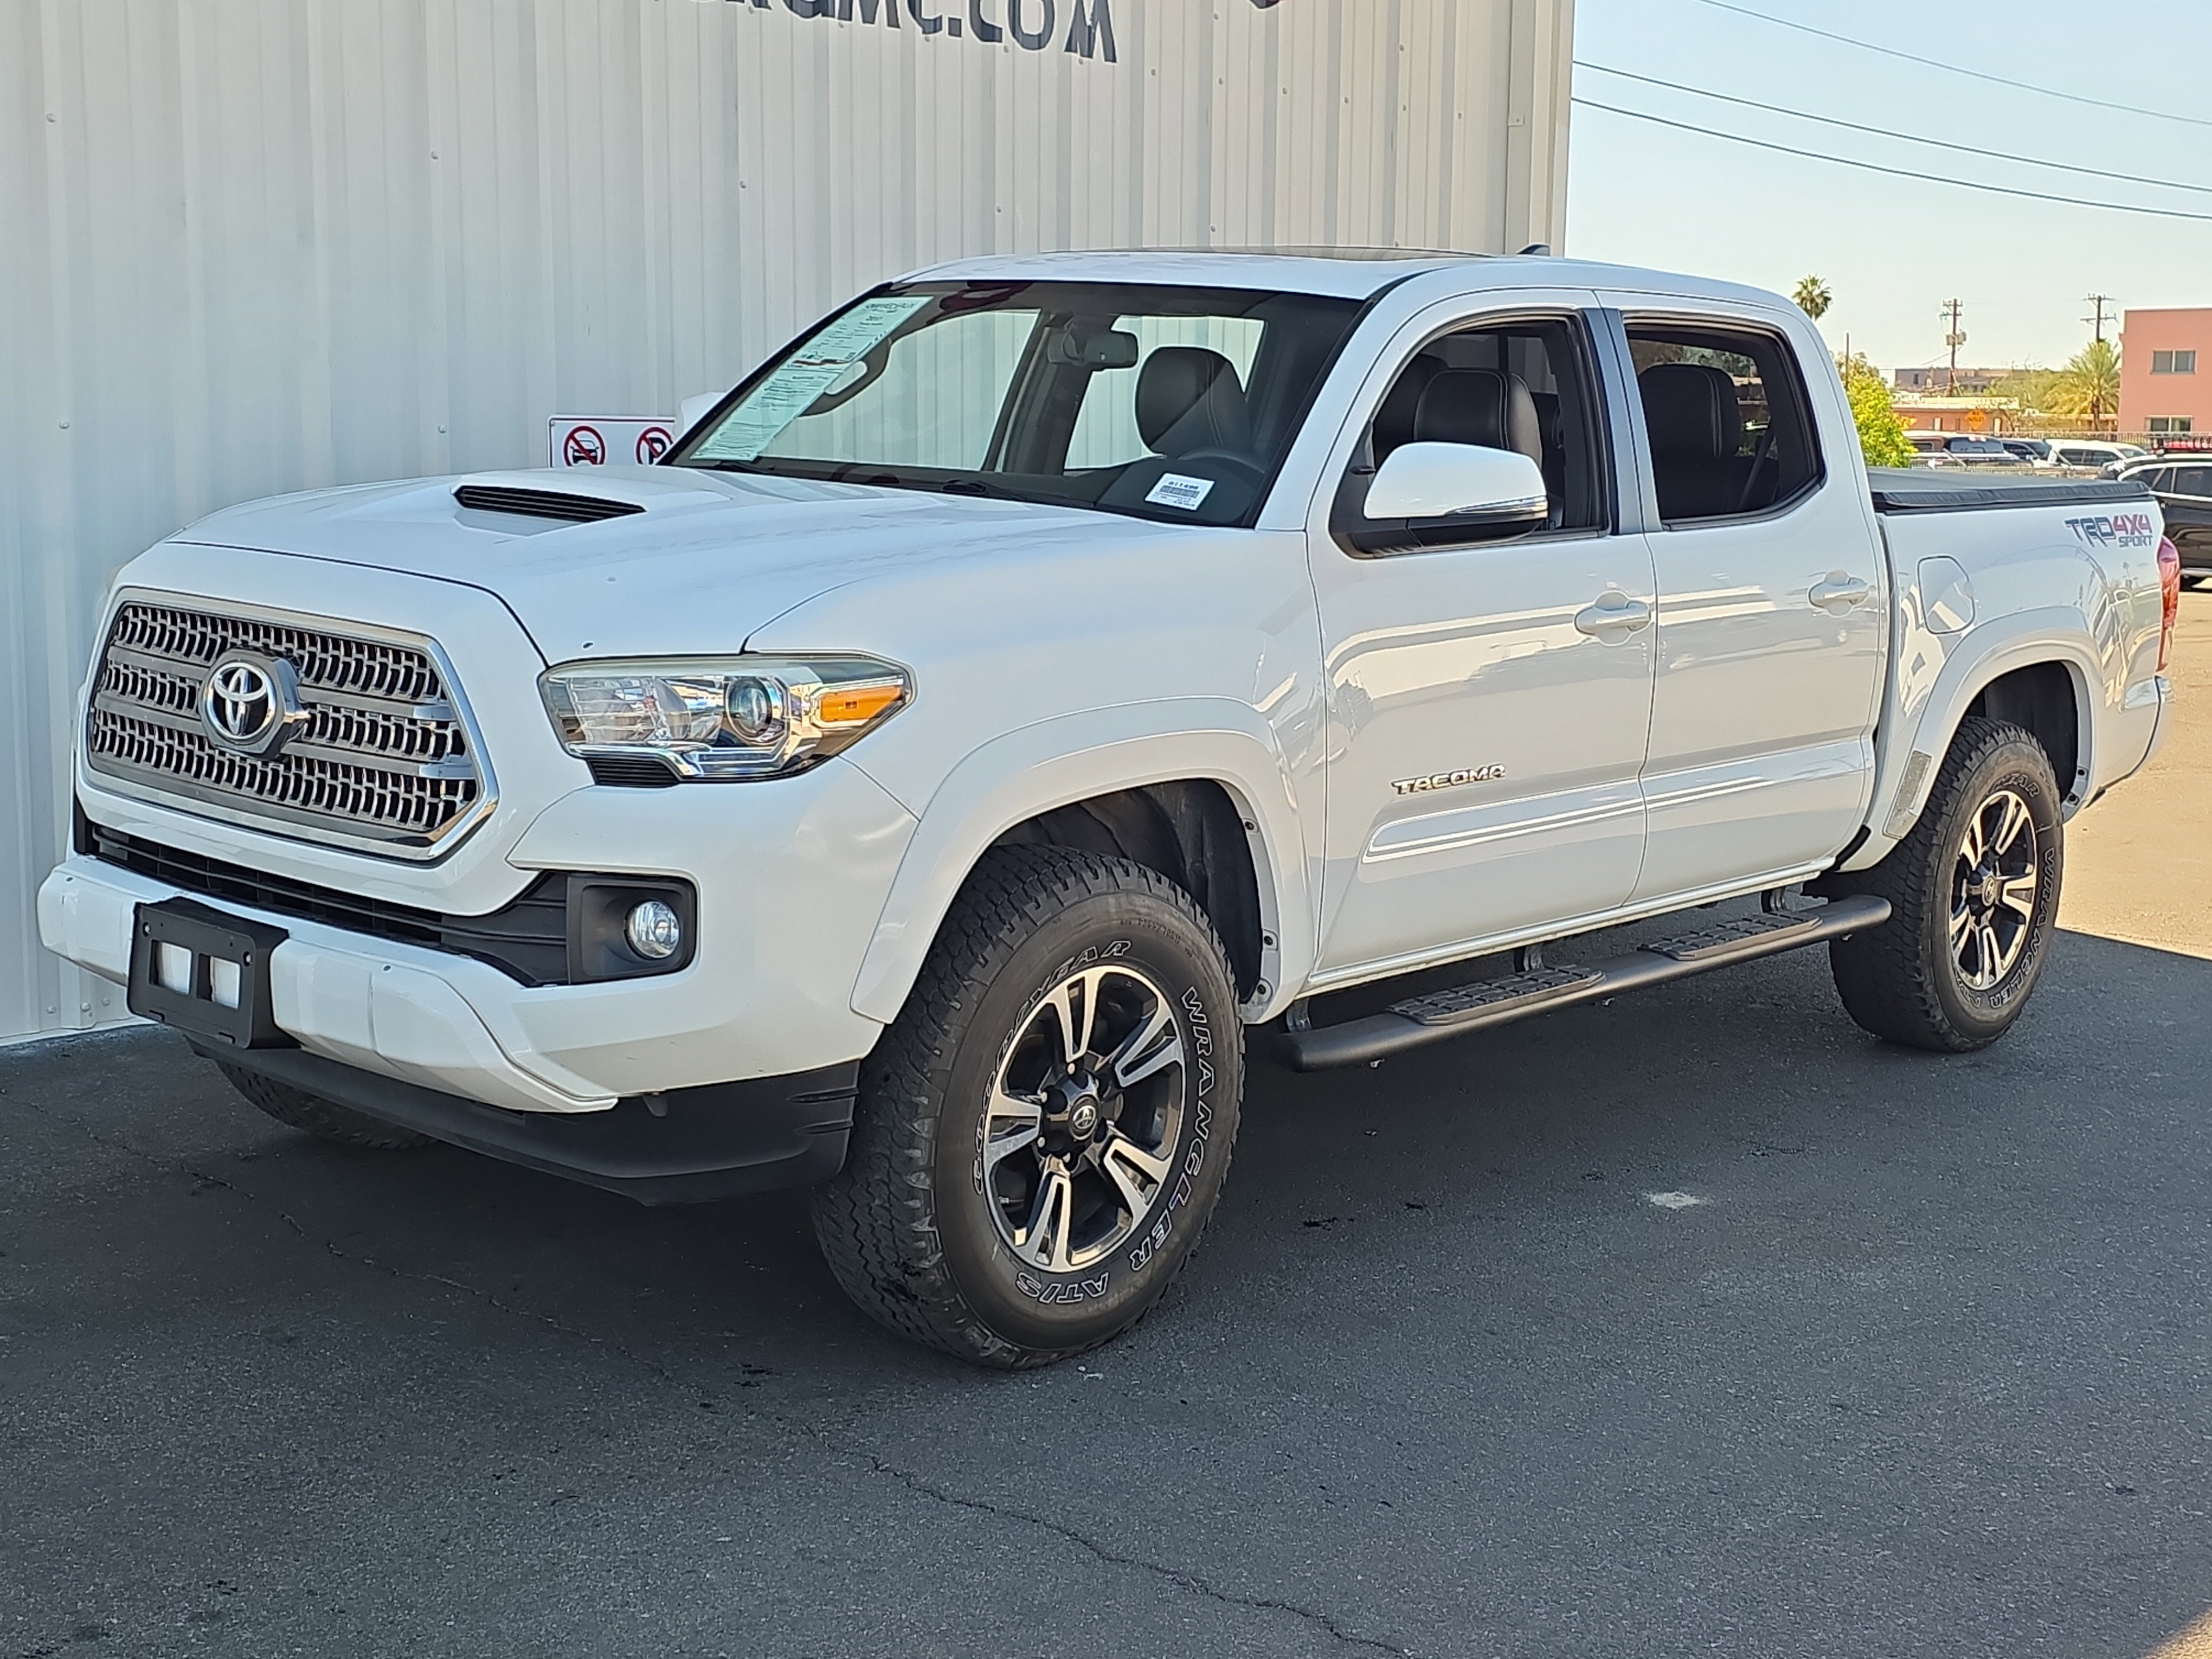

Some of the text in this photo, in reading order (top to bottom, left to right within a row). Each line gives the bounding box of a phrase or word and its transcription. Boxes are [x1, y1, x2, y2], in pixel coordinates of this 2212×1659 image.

[2064, 516, 2117, 548] TRD
[2118, 535, 2153, 548] SPORT
[1390, 763, 1506, 795] TACOMA
[1989, 846, 2055, 1009] WRANGLER
[1128, 986, 1216, 1272] WRANGLER
